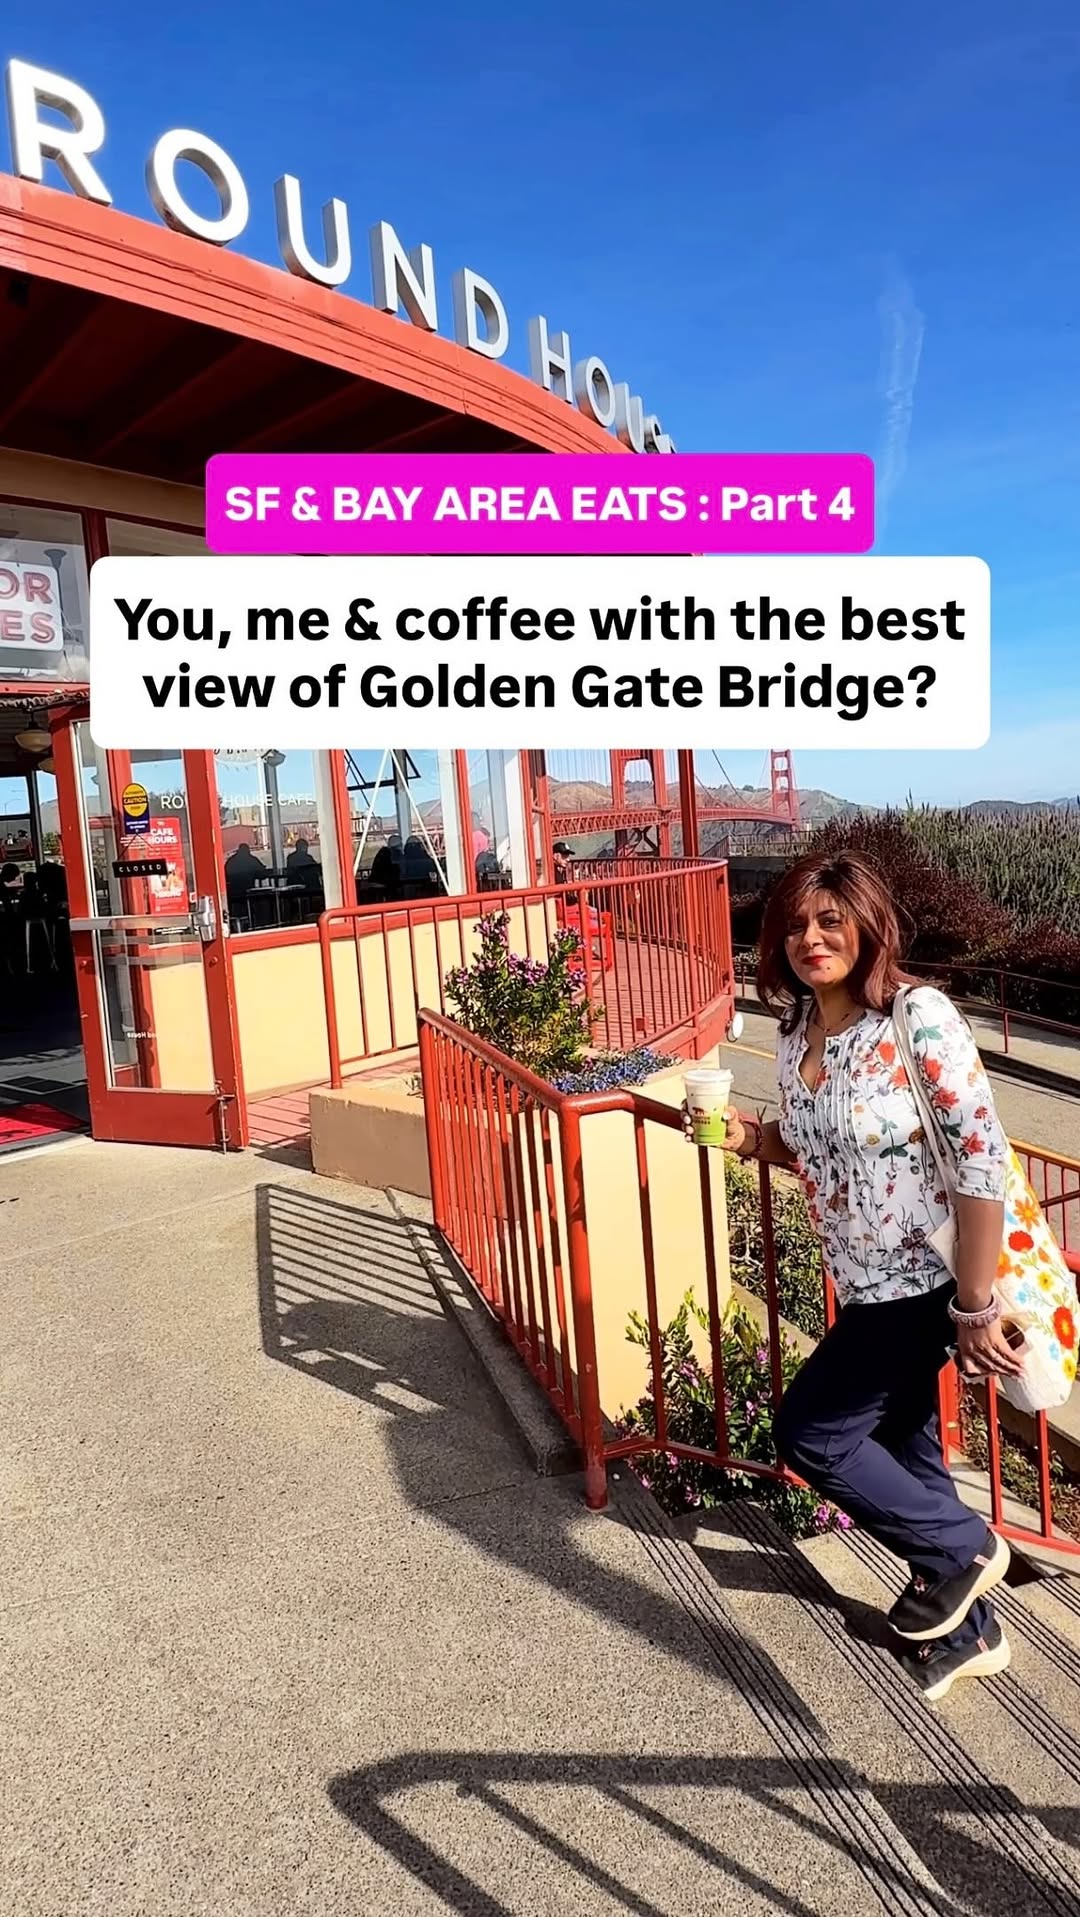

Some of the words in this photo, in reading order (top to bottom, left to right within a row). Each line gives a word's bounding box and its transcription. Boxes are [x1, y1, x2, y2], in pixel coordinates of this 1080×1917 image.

[279, 792, 314, 806] CAFE
[151, 828, 173, 836] CAFE
[148, 836, 177, 844] HOURS
[119, 864, 161, 872] CLOSED
